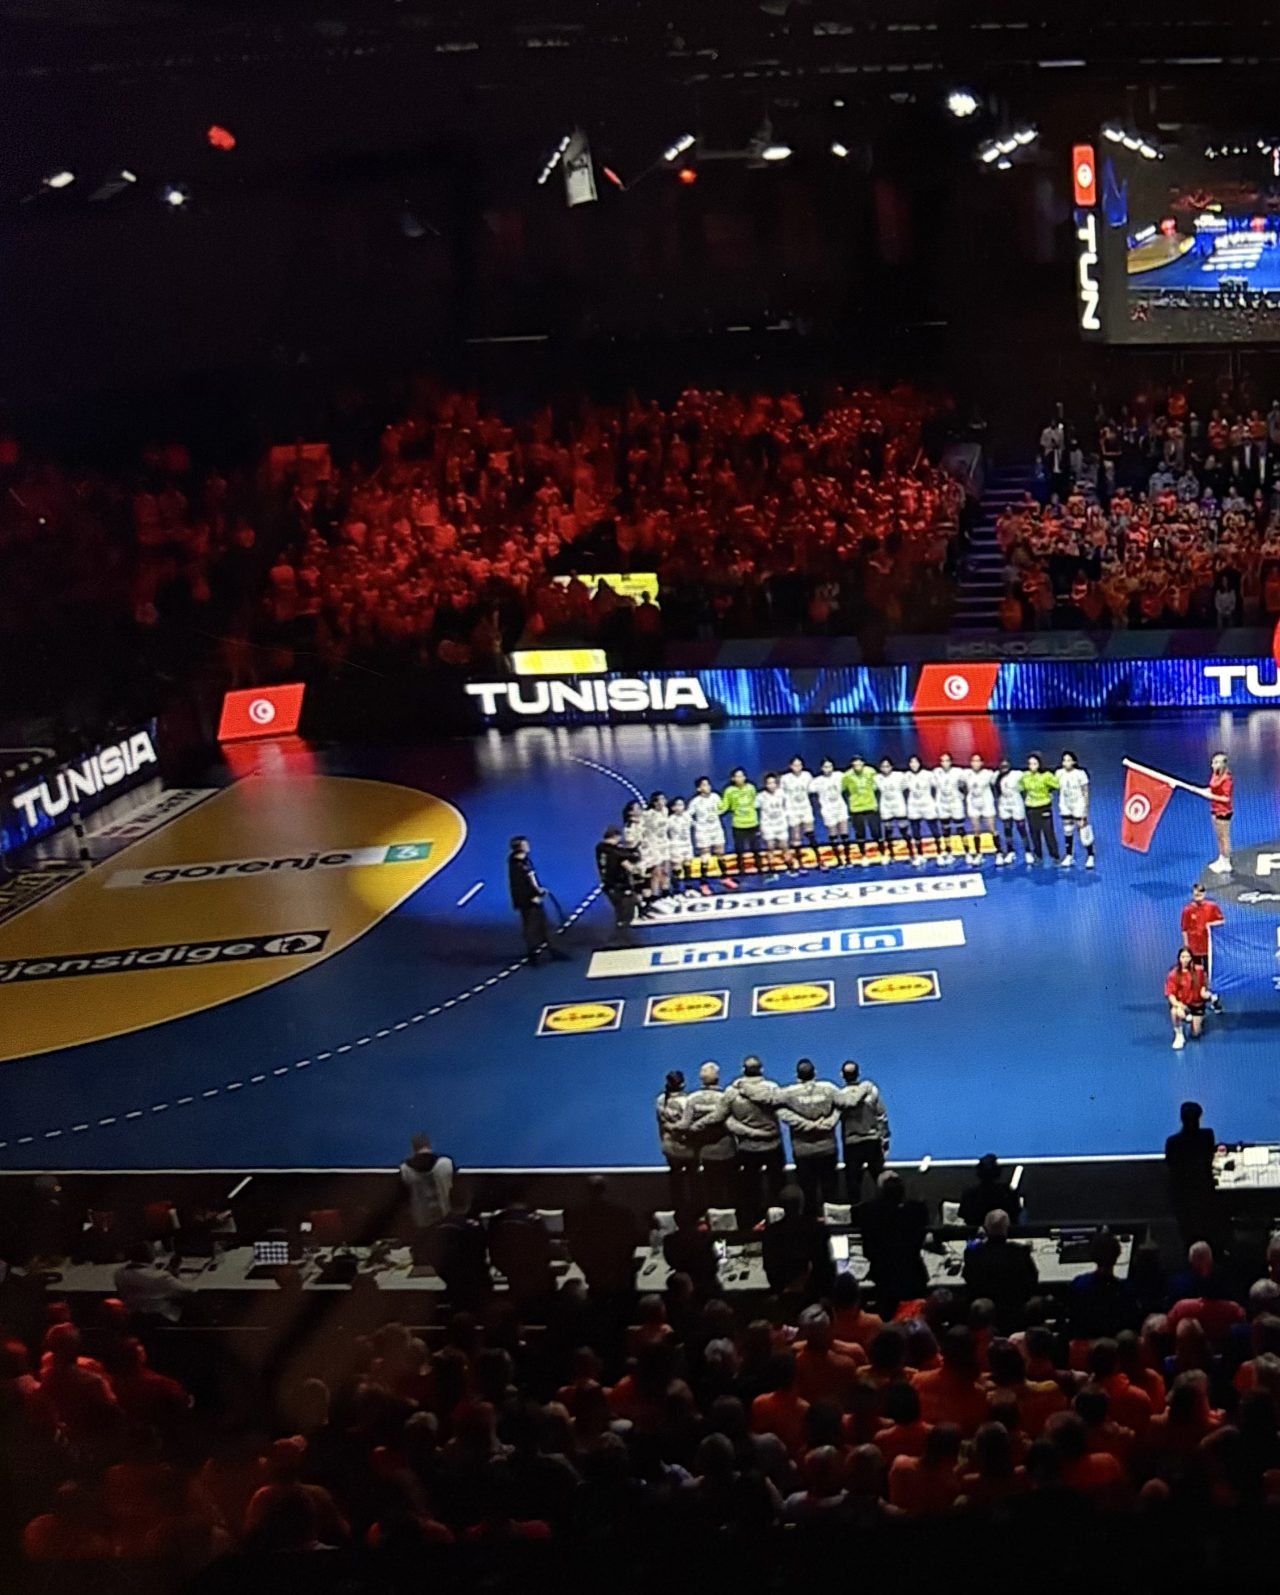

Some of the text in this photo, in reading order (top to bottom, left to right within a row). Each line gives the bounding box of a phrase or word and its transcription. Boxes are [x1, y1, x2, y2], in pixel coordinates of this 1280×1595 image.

[1077, 214, 1100, 331] TUN
[465, 677, 710, 715] TUNISIA
[12, 730, 158, 828] TUNISIA
[141, 850, 353, 886] gorenje
